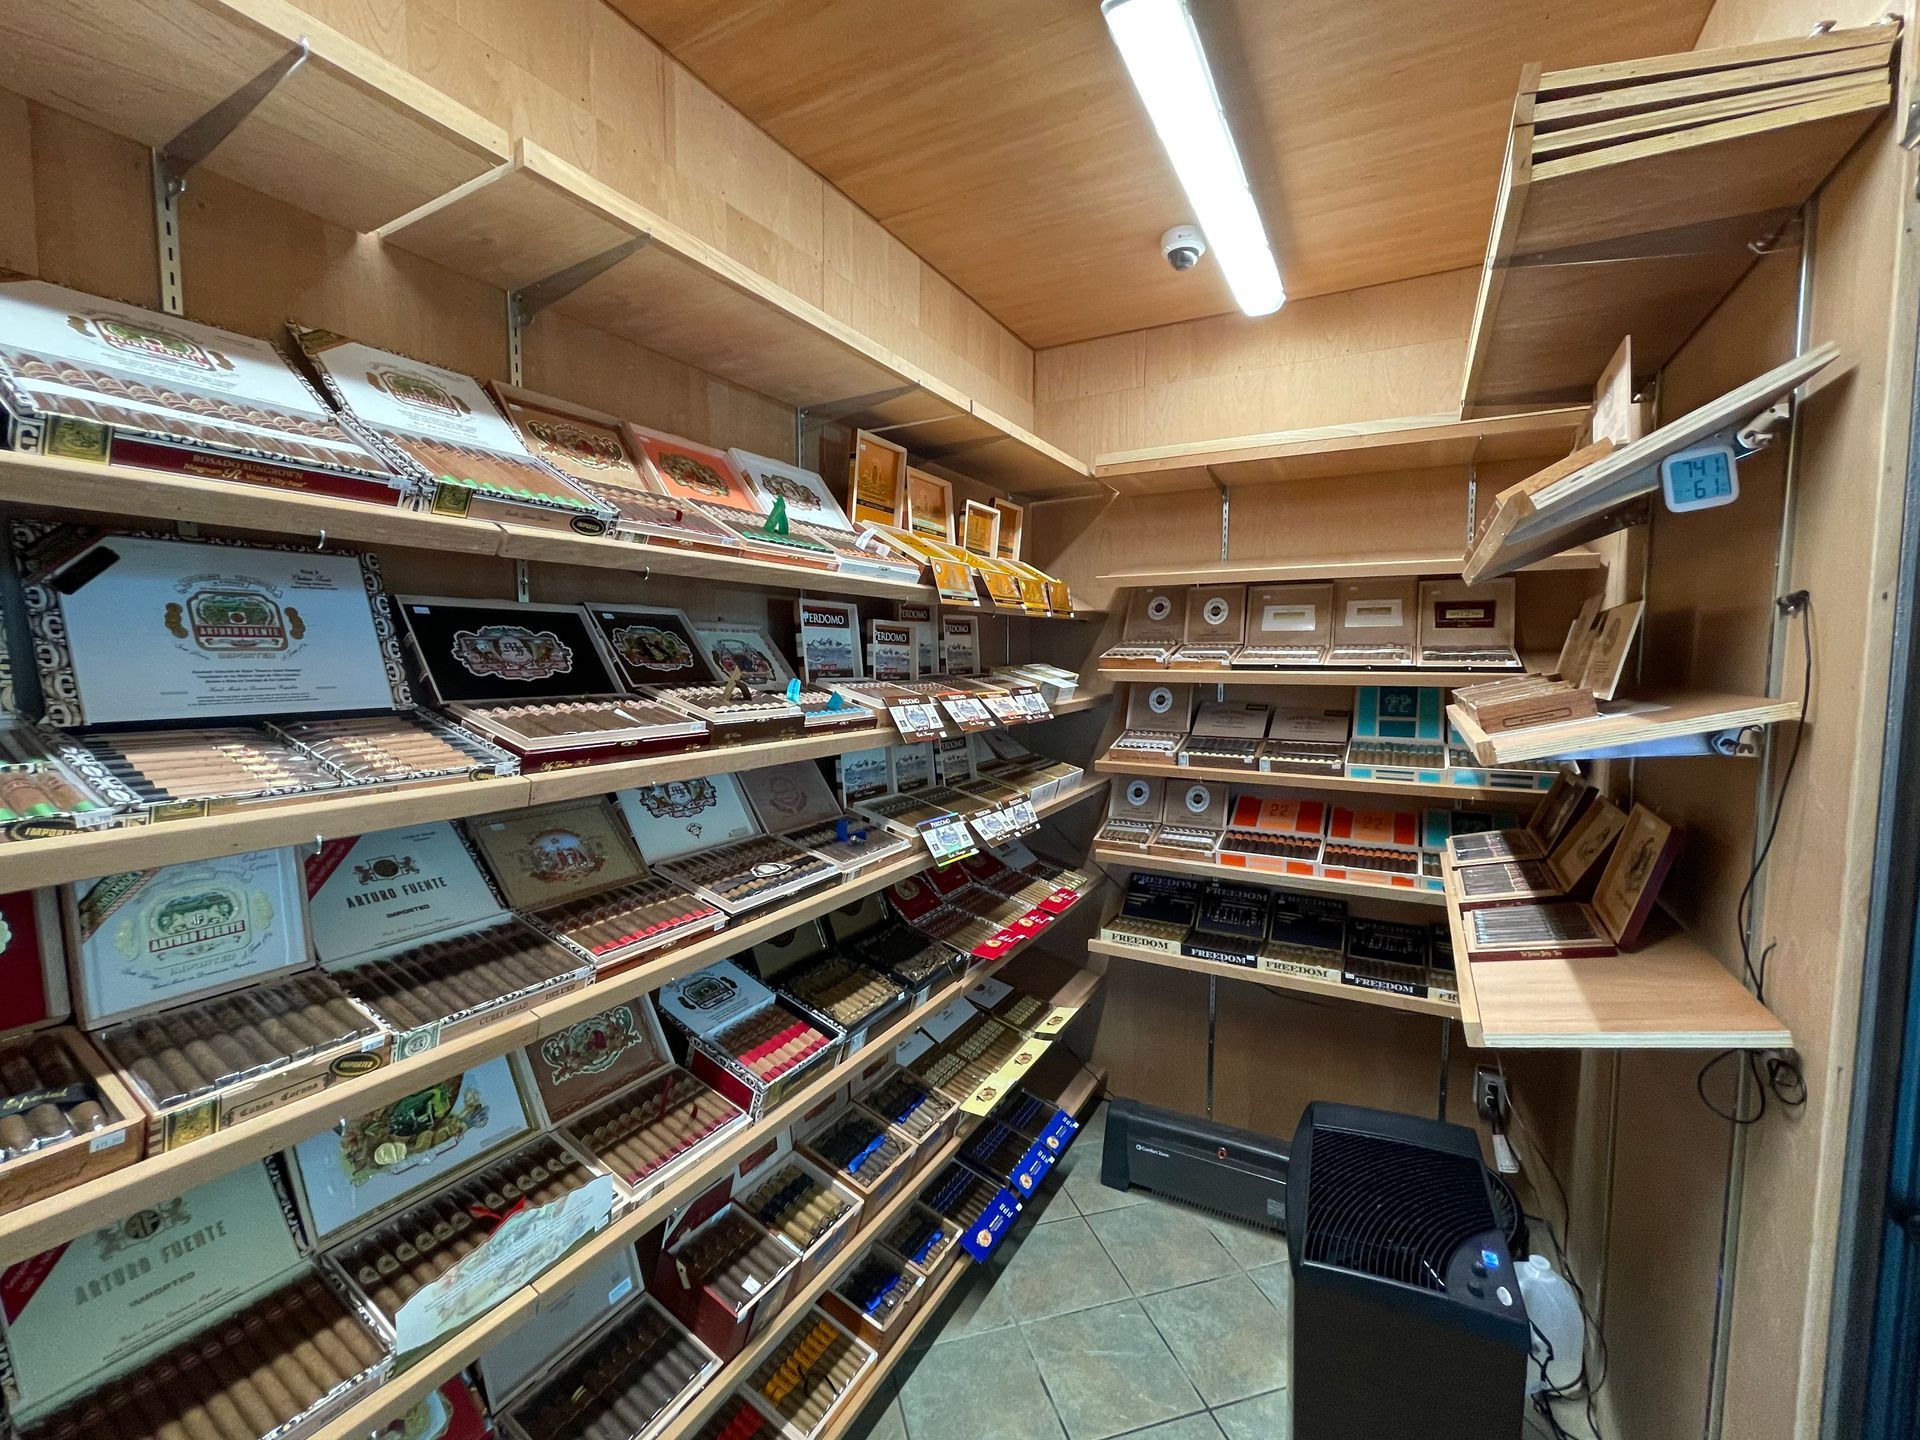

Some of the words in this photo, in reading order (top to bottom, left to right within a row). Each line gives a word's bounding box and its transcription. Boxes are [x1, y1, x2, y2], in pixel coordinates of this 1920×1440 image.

[184, 463, 223, 476] Magnum
[193, 455, 241, 469] ROSADO
[242, 462, 305, 481] SUNGROWN
[576, 520, 601, 533] IMPORTED
[804, 611, 845, 626] PERDOMO
[902, 609, 928, 619] ERDOMO
[199, 627, 241, 637] ARTURO
[242, 627, 282, 637] FUENTE
[897, 697, 921, 706] PERDOMO
[941, 739, 965, 751] ERDOMO
[1269, 803, 1290, 817] 22
[1362, 816, 1384, 831] 22
[1133, 874, 1198, 890] FREEDOM
[346, 887, 398, 909] ARTURO
[402, 876, 447, 897] FUENTE
[1205, 886, 1269, 902] FREEDOM
[386, 903, 431, 919] IMPORTED
[150, 932, 198, 952] ARTURO
[197, 919, 246, 940] FUENTE
[1111, 932, 1169, 950] FREEDOM
[1190, 948, 1247, 965] FREEDOM
[1265, 960, 1329, 978] FREEDOM
[1355, 976, 1414, 994] FREEDOM
[479, 1012, 505, 1026] CURLY
[506, 1001, 529, 1015] HEAD
[545, 984, 577, 1001] DELUXE
[340, 1060, 375, 1069] IMPORTED
[239, 1100, 275, 1117] Cuban
[280, 1081, 319, 1102] Corona
[75, 1258, 152, 1306] ARTURO
[162, 1219, 228, 1264] FUENTE
